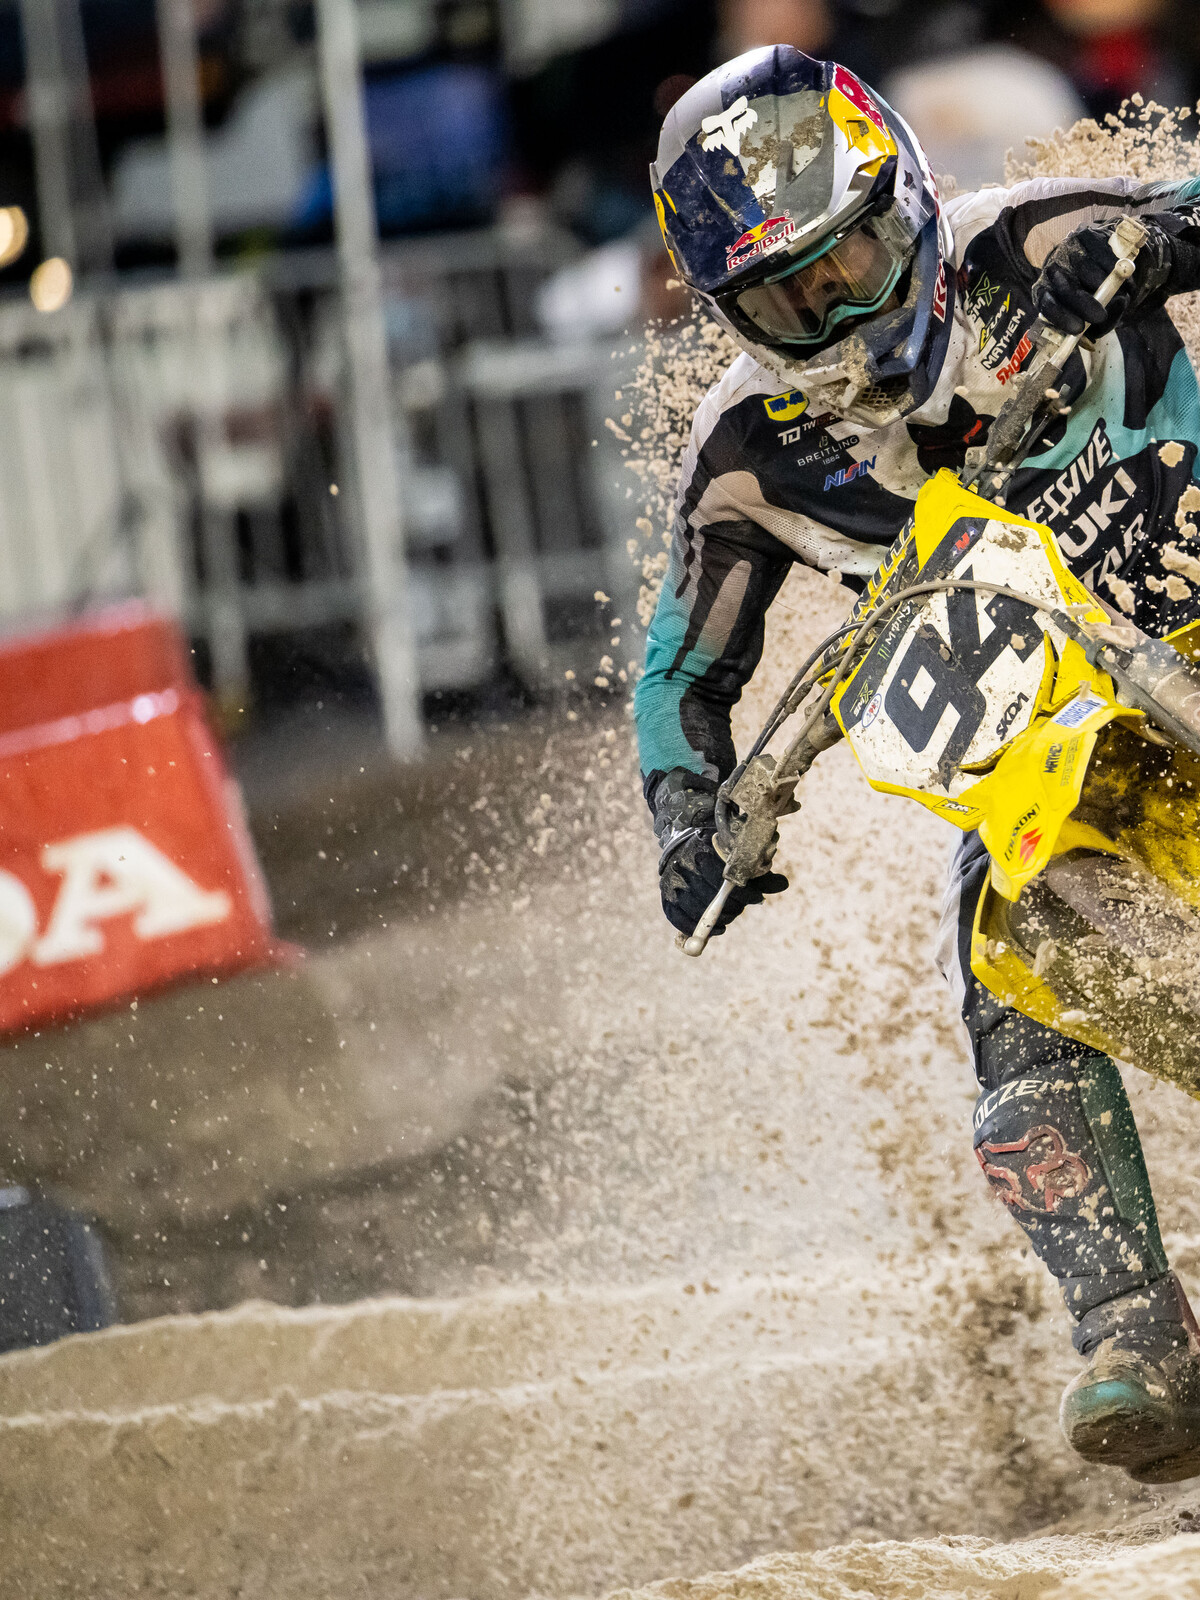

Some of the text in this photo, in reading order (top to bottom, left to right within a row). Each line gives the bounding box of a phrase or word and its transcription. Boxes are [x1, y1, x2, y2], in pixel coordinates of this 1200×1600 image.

[726, 220, 796, 271] Red Bull
[981, 308, 1026, 370] MAYHEM
[797, 436, 859, 467] BREITLING
[823, 455, 840, 465] 1884
[1027, 427, 1113, 526] ESSIVE
[1057, 466, 1138, 558] UKI
[1079, 513, 1145, 592] TAR
[884, 564, 1045, 793] 94
[996, 692, 1030, 741] SKDA
